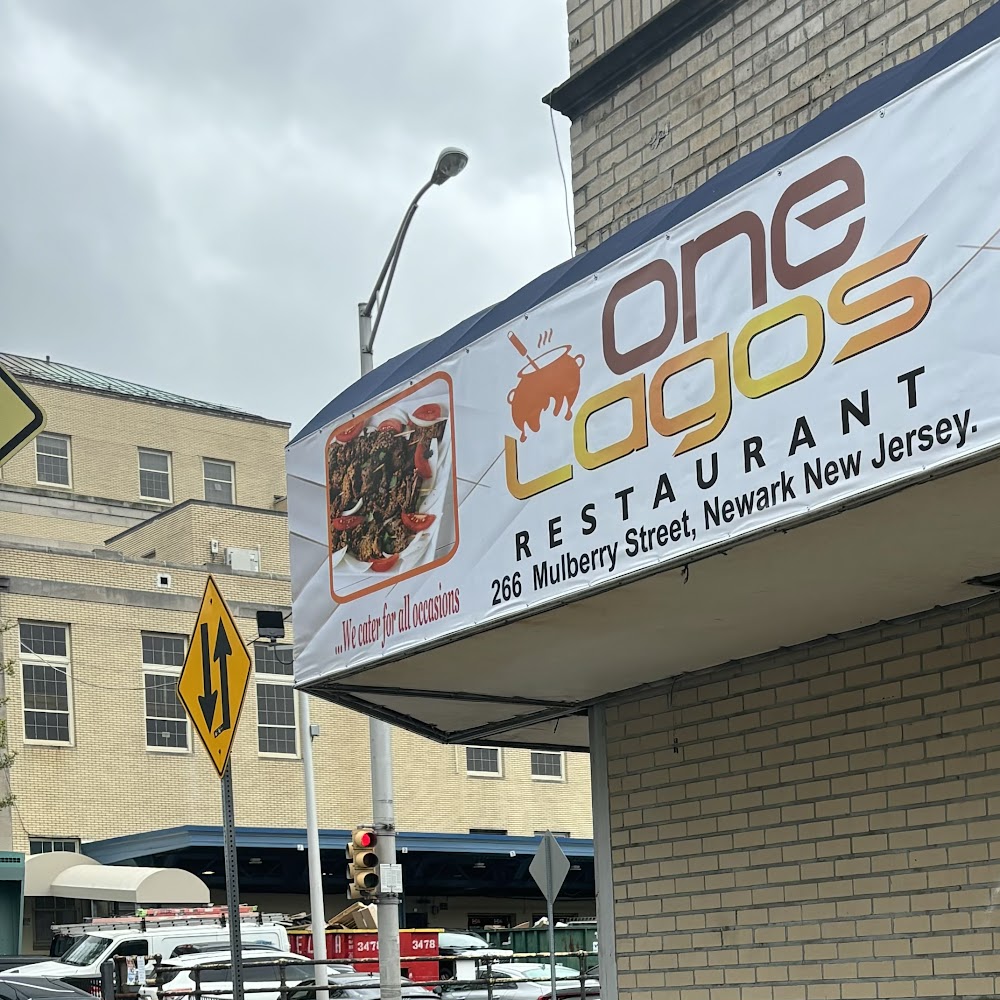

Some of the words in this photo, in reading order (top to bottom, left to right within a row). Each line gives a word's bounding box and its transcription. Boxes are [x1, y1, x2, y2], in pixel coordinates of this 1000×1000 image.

[602, 155, 866, 375] one
[504, 234, 932, 500] Lagos
[515, 366, 925, 561] RESTAURANT
[491, 571, 522, 606] 266
[533, 541, 618, 591] Mulberry
[625, 509, 696, 558] Street,
[704, 471, 797, 530] Newark
[803, 450, 862, 494] New
[871, 408, 978, 470] Jersey.
[358, 614, 381, 647] cater
[381, 602, 396, 648] for
[398, 593, 410, 633] all
[412, 582, 460, 628] occasions
[412, 939, 436, 950] 3478
